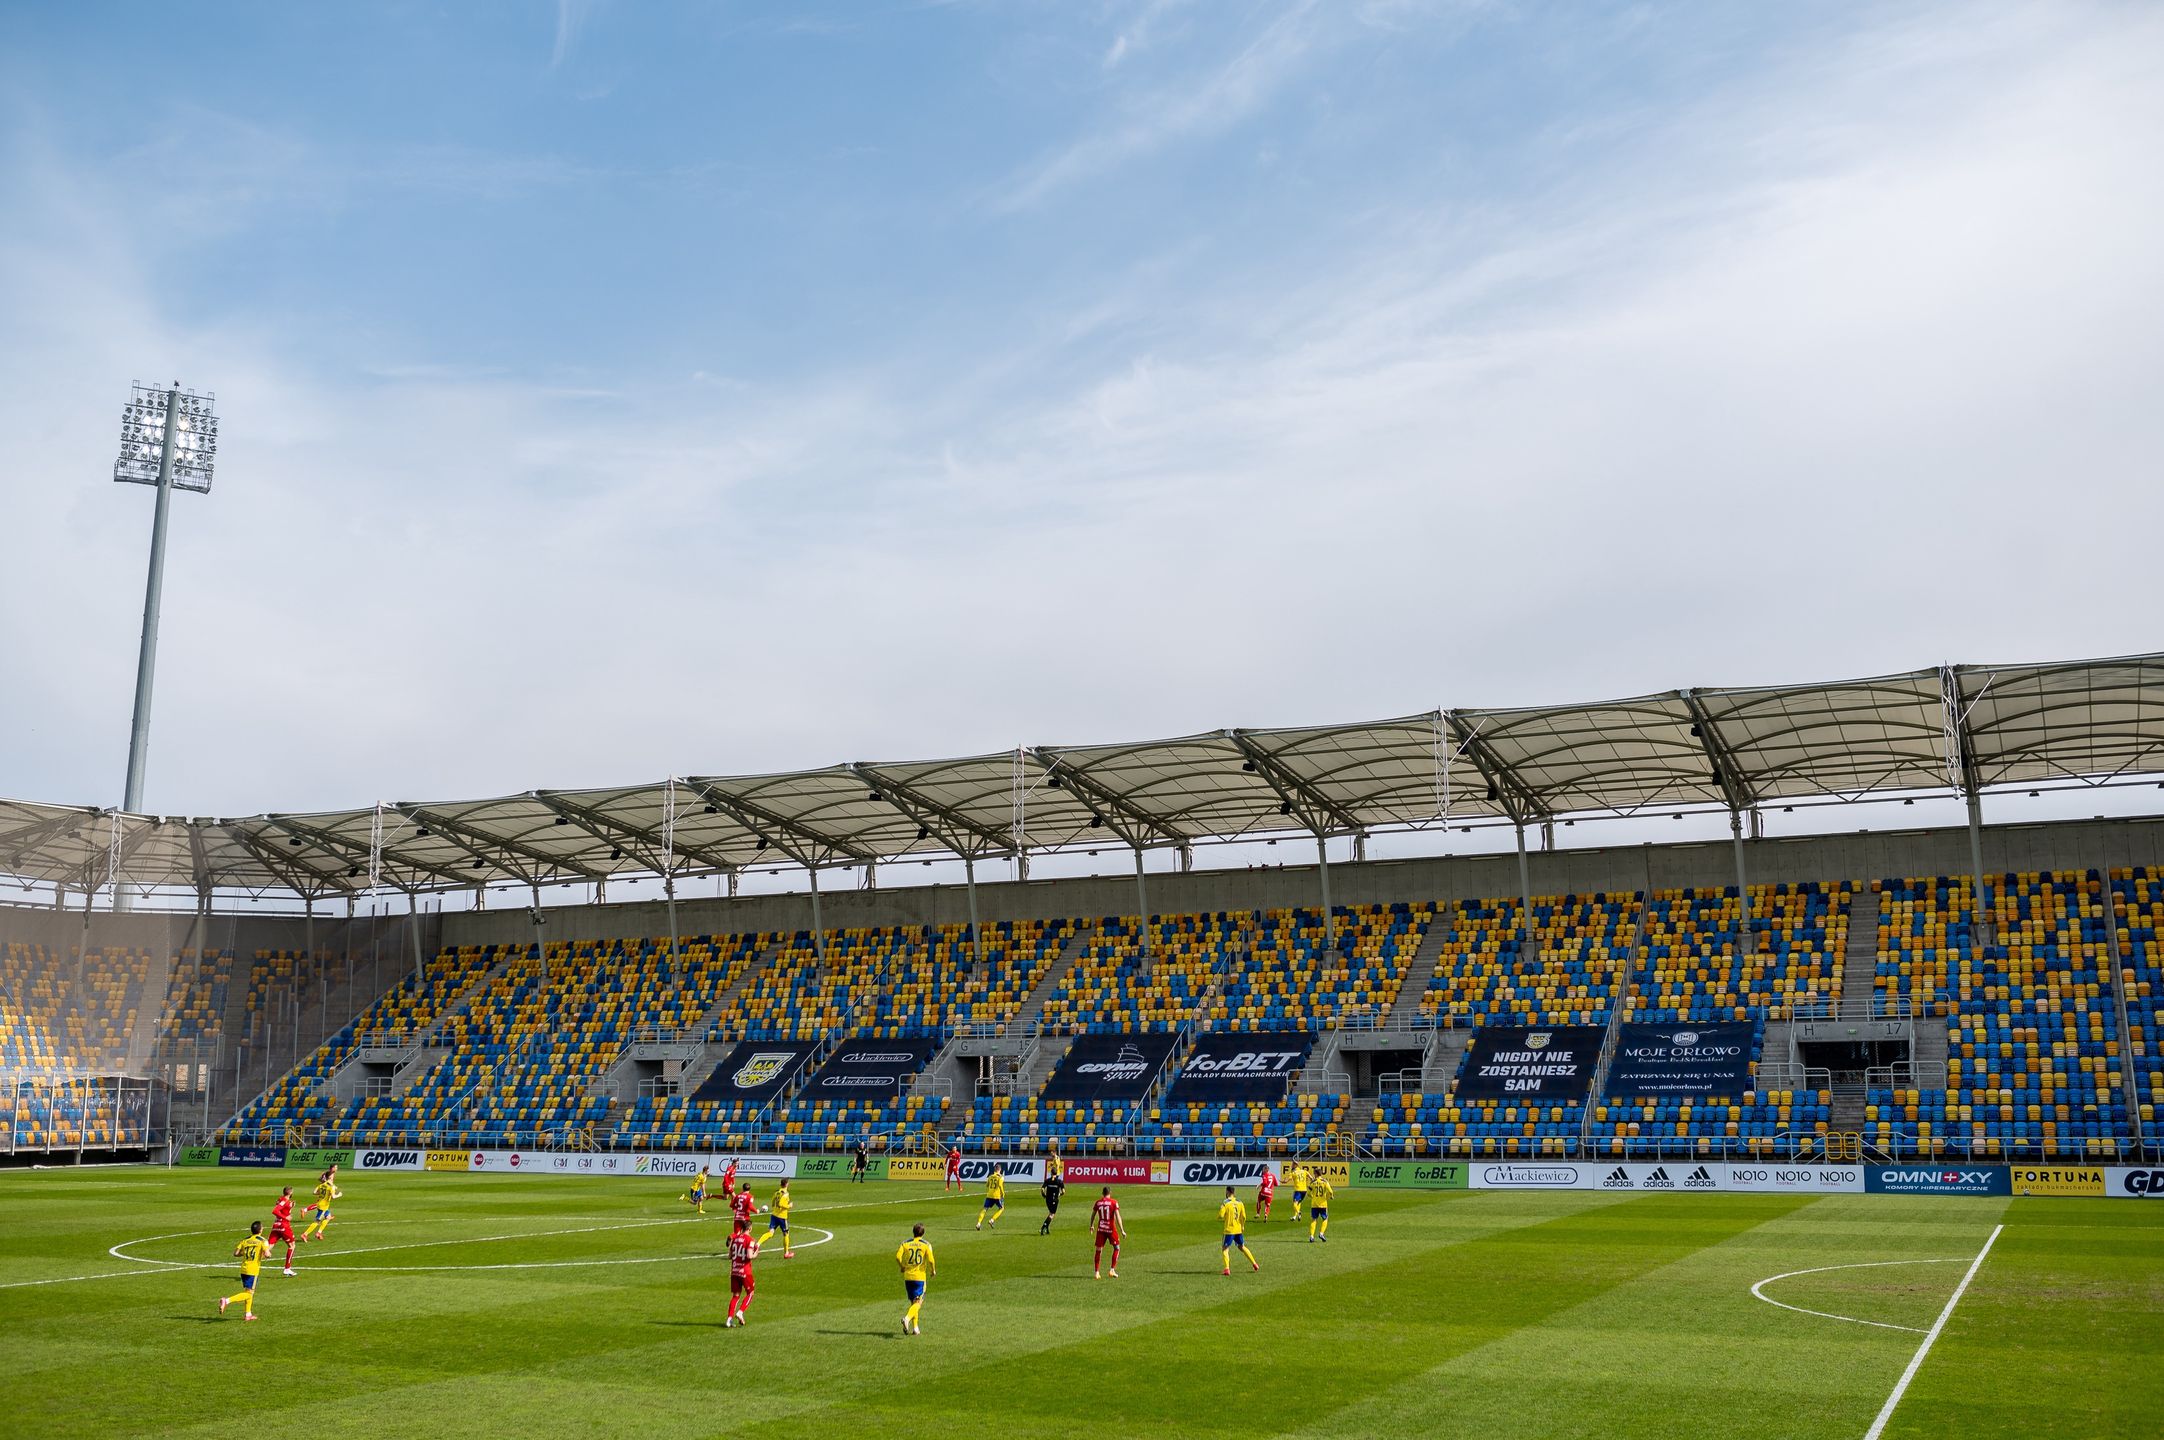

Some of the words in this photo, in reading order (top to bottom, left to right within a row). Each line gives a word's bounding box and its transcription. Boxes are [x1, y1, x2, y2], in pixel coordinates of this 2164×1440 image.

[1804, 1024, 1814, 1035] H
[1886, 1022, 1902, 1035] 17
[1345, 1034, 1353, 1045] H
[1413, 1033, 1427, 1044] 16
[1493, 1052, 1542, 1062] NIGDY
[1545, 1051, 1573, 1062] NIE
[1625, 1047, 1667, 1057] MOJE
[1671, 1046, 1741, 1056] ORŁOWO
[1185, 1052, 1301, 1071] forBET
[1076, 1062, 1149, 1073] GDYNIA
[1479, 1065, 1577, 1076] ZOSTANIESZ
[1103, 1070, 1143, 1081] sport
[1504, 1079, 1541, 1091] SAM
[188, 1150, 213, 1160] forBET
[291, 1152, 317, 1162] forBET
[323, 1152, 350, 1162] forBET
[362, 1151, 418, 1167] GDYNIA
[426, 1153, 469, 1162] FORTUNA
[651, 1157, 697, 1172] Riviera
[803, 1160, 837, 1171] forBET
[890, 1160, 945, 1170] FORTUNA
[1068, 1167, 1119, 1176] FORTUNA
[1129, 1167, 1146, 1176] LIGA
[1359, 1166, 1402, 1178] forBET
[1414, 1167, 1458, 1179] forBET
[1495, 1166, 1570, 1182] Mackiewicz
[2014, 1171, 2102, 1182] FORTUNA
[1603, 1179, 1634, 1188] adidas
[1643, 1179, 1675, 1188] adidas
[1684, 1179, 1716, 1188] adidas
[737, 1198, 743, 1210] 5
[1098, 1205, 1110, 1220] 11
[244, 1245, 256, 1260] 14
[732, 1244, 746, 1260] 34
[908, 1248, 923, 1264] 26
